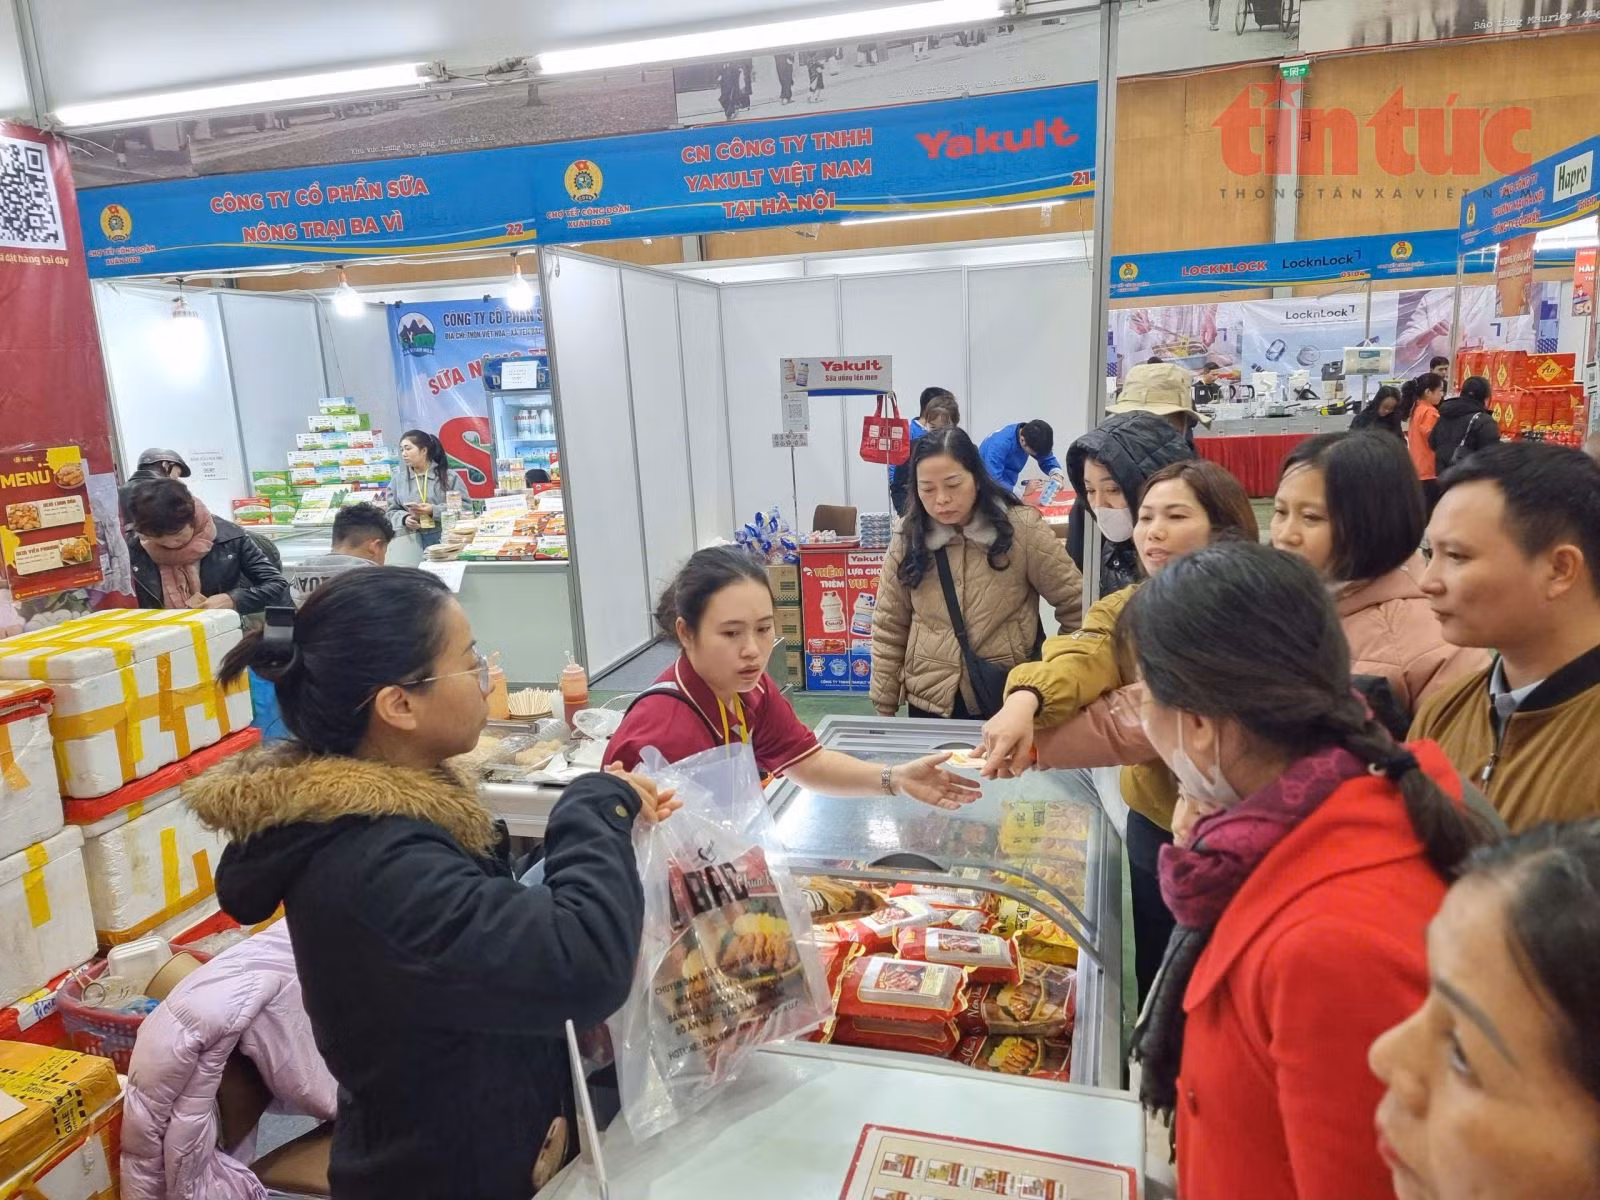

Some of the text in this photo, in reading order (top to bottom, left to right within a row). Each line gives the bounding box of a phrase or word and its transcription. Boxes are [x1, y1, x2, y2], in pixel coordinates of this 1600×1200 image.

[681, 128, 872, 164] CN CÔNG TY TNHH
[916, 117, 1080, 160] Yakult
[684, 158, 872, 192] YAKULT VIỆT NAM
[1072, 170, 1091, 186] 21
[1558, 164, 1587, 194] Hapro
[210, 174, 429, 214] CÔNG TY CỔ PHẦN SỮA
[722, 188, 836, 222] TẠI HÀ NỘI
[242, 209, 404, 244] NÔNG TRẠI BA VÌ
[506, 222, 524, 237] 22
[1182, 260, 1268, 277] LOCKNLOCK
[1282, 254, 1354, 270] LocknLock
[444, 310, 470, 327] CÔNG
[474, 311, 486, 326] TY
[490, 306, 502, 324] CỔ
[1285, 308, 1348, 320] LocknLock
[821, 360, 883, 372] Yakult
[428, 367, 465, 396] SỮA
[0, 470, 50, 488] MENU
[814, 564, 844, 578] THÊM
[820, 579, 844, 588] THÊM
